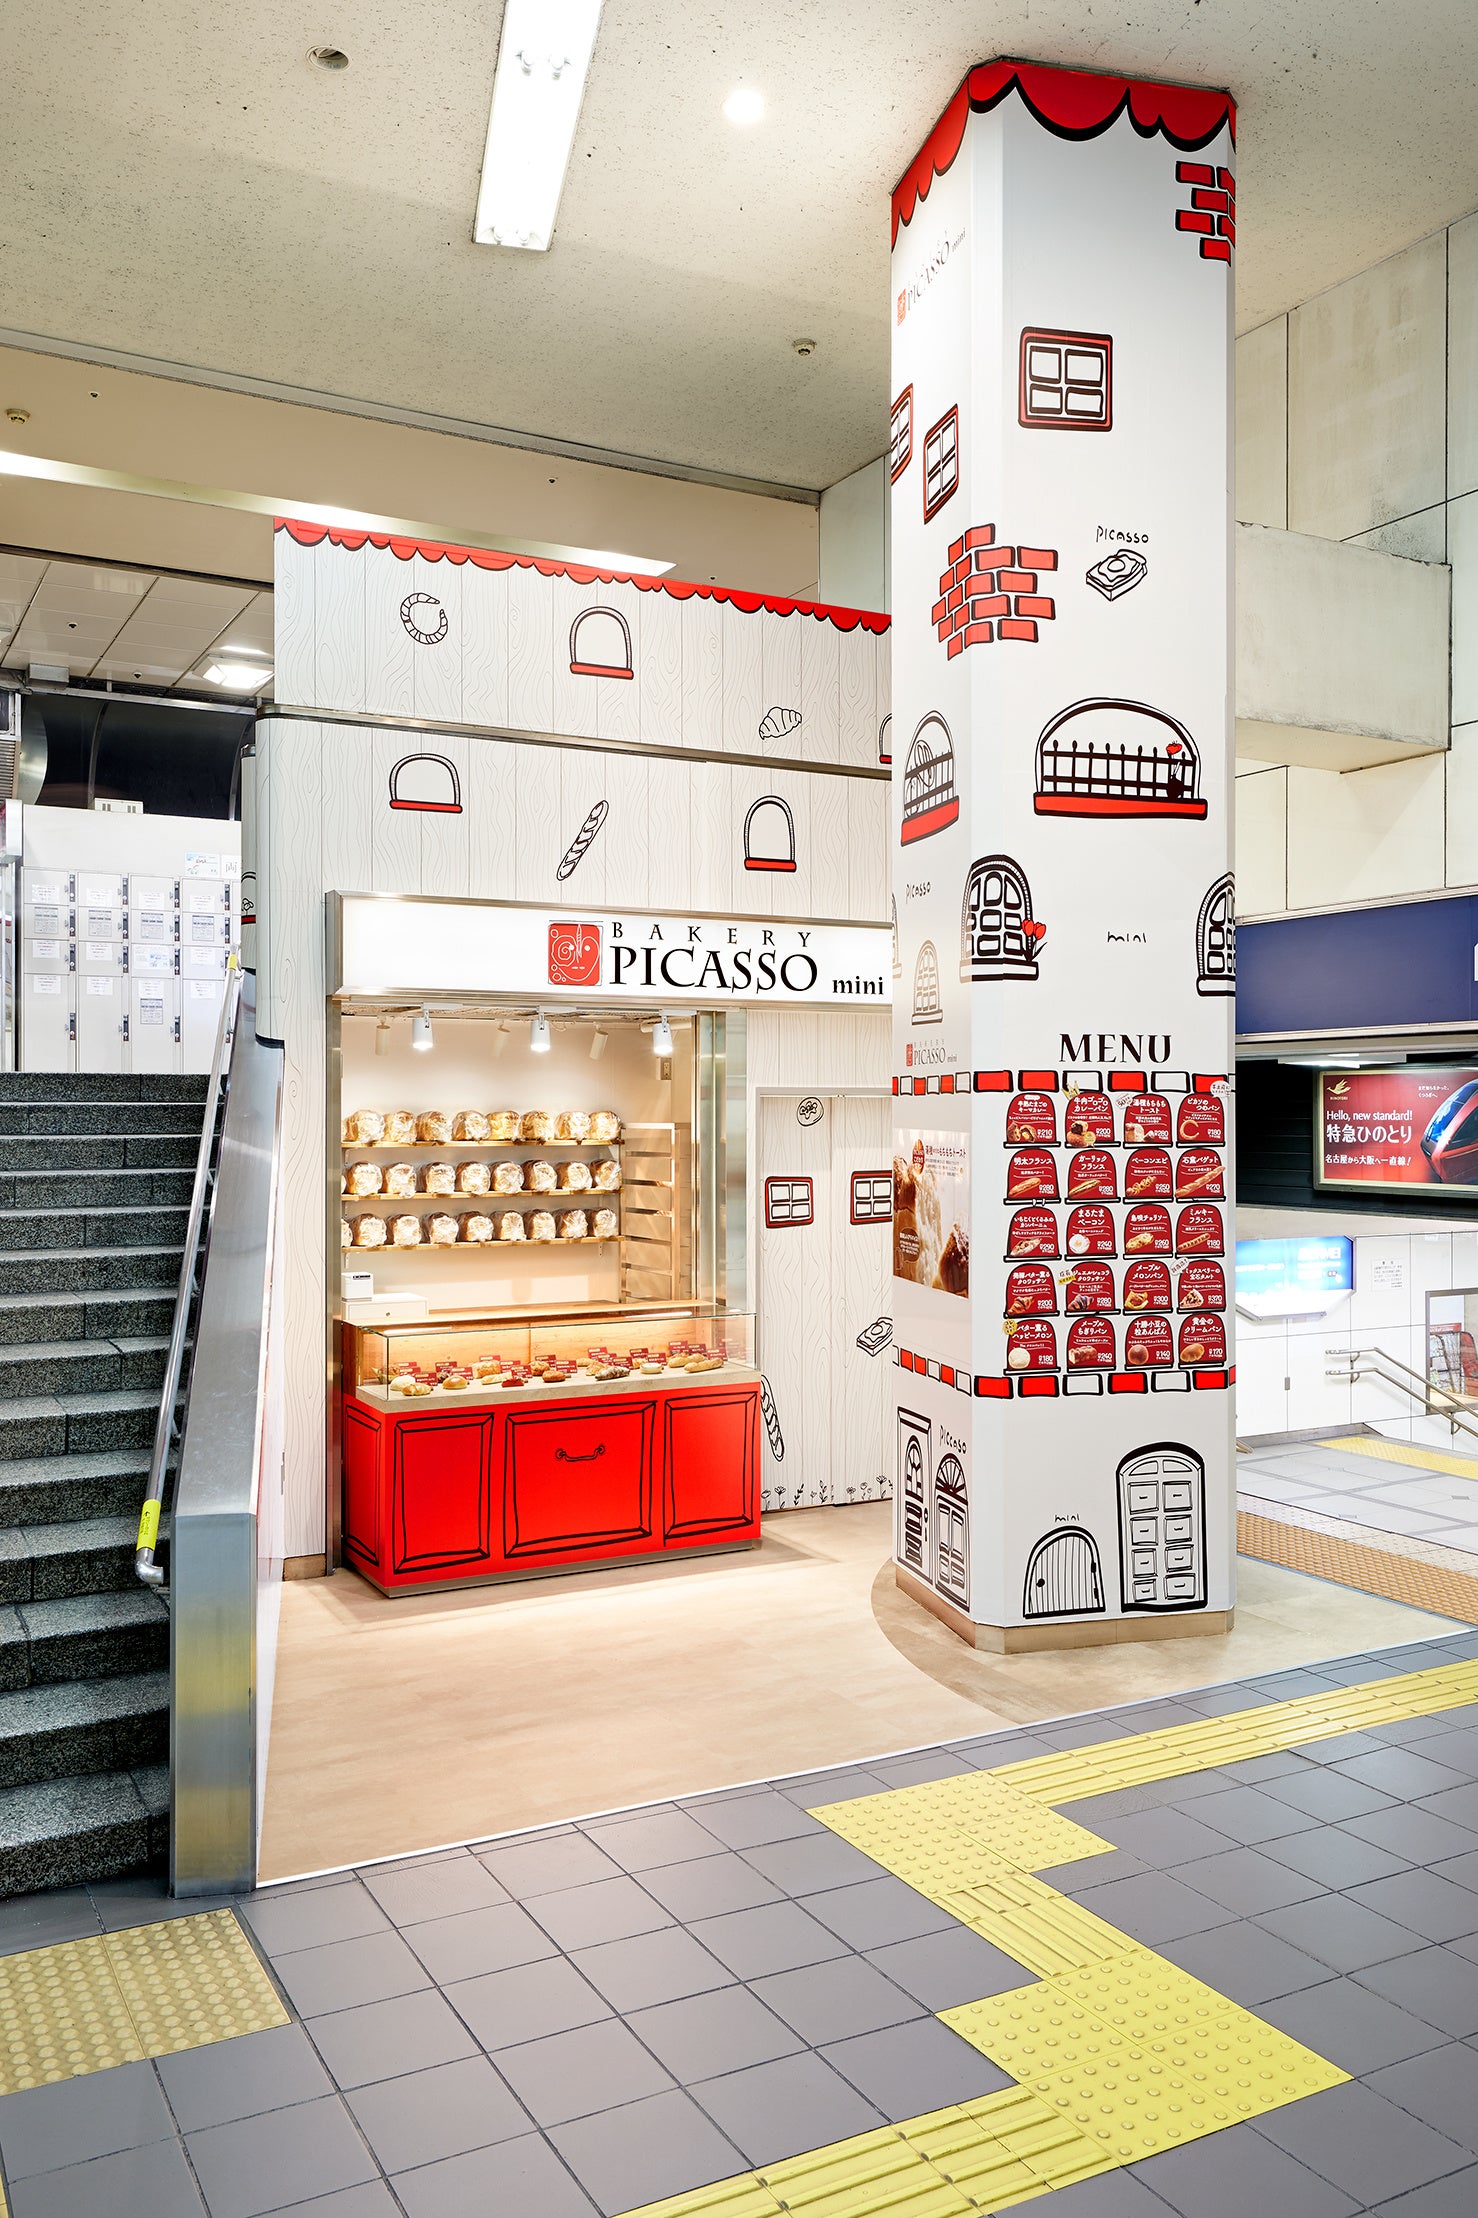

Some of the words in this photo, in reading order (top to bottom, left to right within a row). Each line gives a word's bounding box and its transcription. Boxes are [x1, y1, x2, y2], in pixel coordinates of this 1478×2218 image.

[612, 922, 811, 947] BAKERY
[609, 945, 818, 994] PICASSO
[832, 975, 884, 995] mini
[1059, 1033, 1172, 1063] MENU
[1326, 1110, 1351, 1121] Hello,
[1353, 1112, 1370, 1120] new
[1372, 1110, 1413, 1121] standard!
[1326, 1123, 1412, 1144] 特急ひのとり
[1014, 1157, 1053, 1166] 明太フランス
[1078, 1208, 1104, 1218] まるたま
[1190, 1208, 1214, 1216] ミルキー
[1192, 1317, 1214, 1325] 黄金の
[1184, 1326, 1222, 1334] クリームパン
